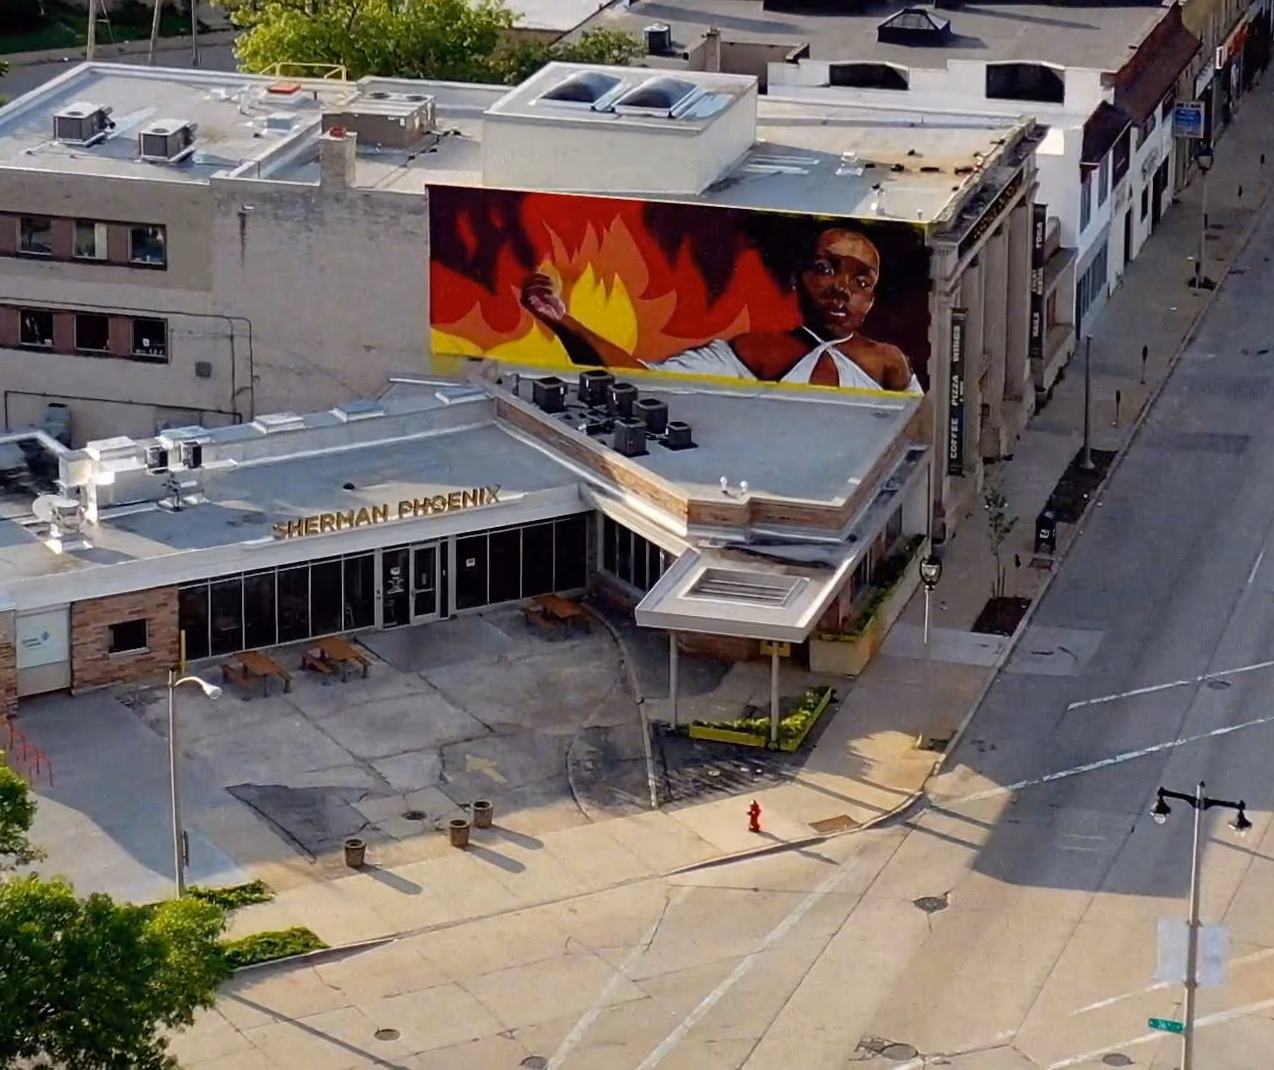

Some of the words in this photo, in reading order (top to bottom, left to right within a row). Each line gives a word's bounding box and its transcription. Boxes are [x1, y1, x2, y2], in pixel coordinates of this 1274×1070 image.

[1035, 221, 1044, 249] YOGA
[951, 375, 960, 407] PIZZA
[950, 417, 959, 459] COFFEE
[272, 503, 389, 541] SHERMAN
[398, 483, 502, 519] PHOENIX
